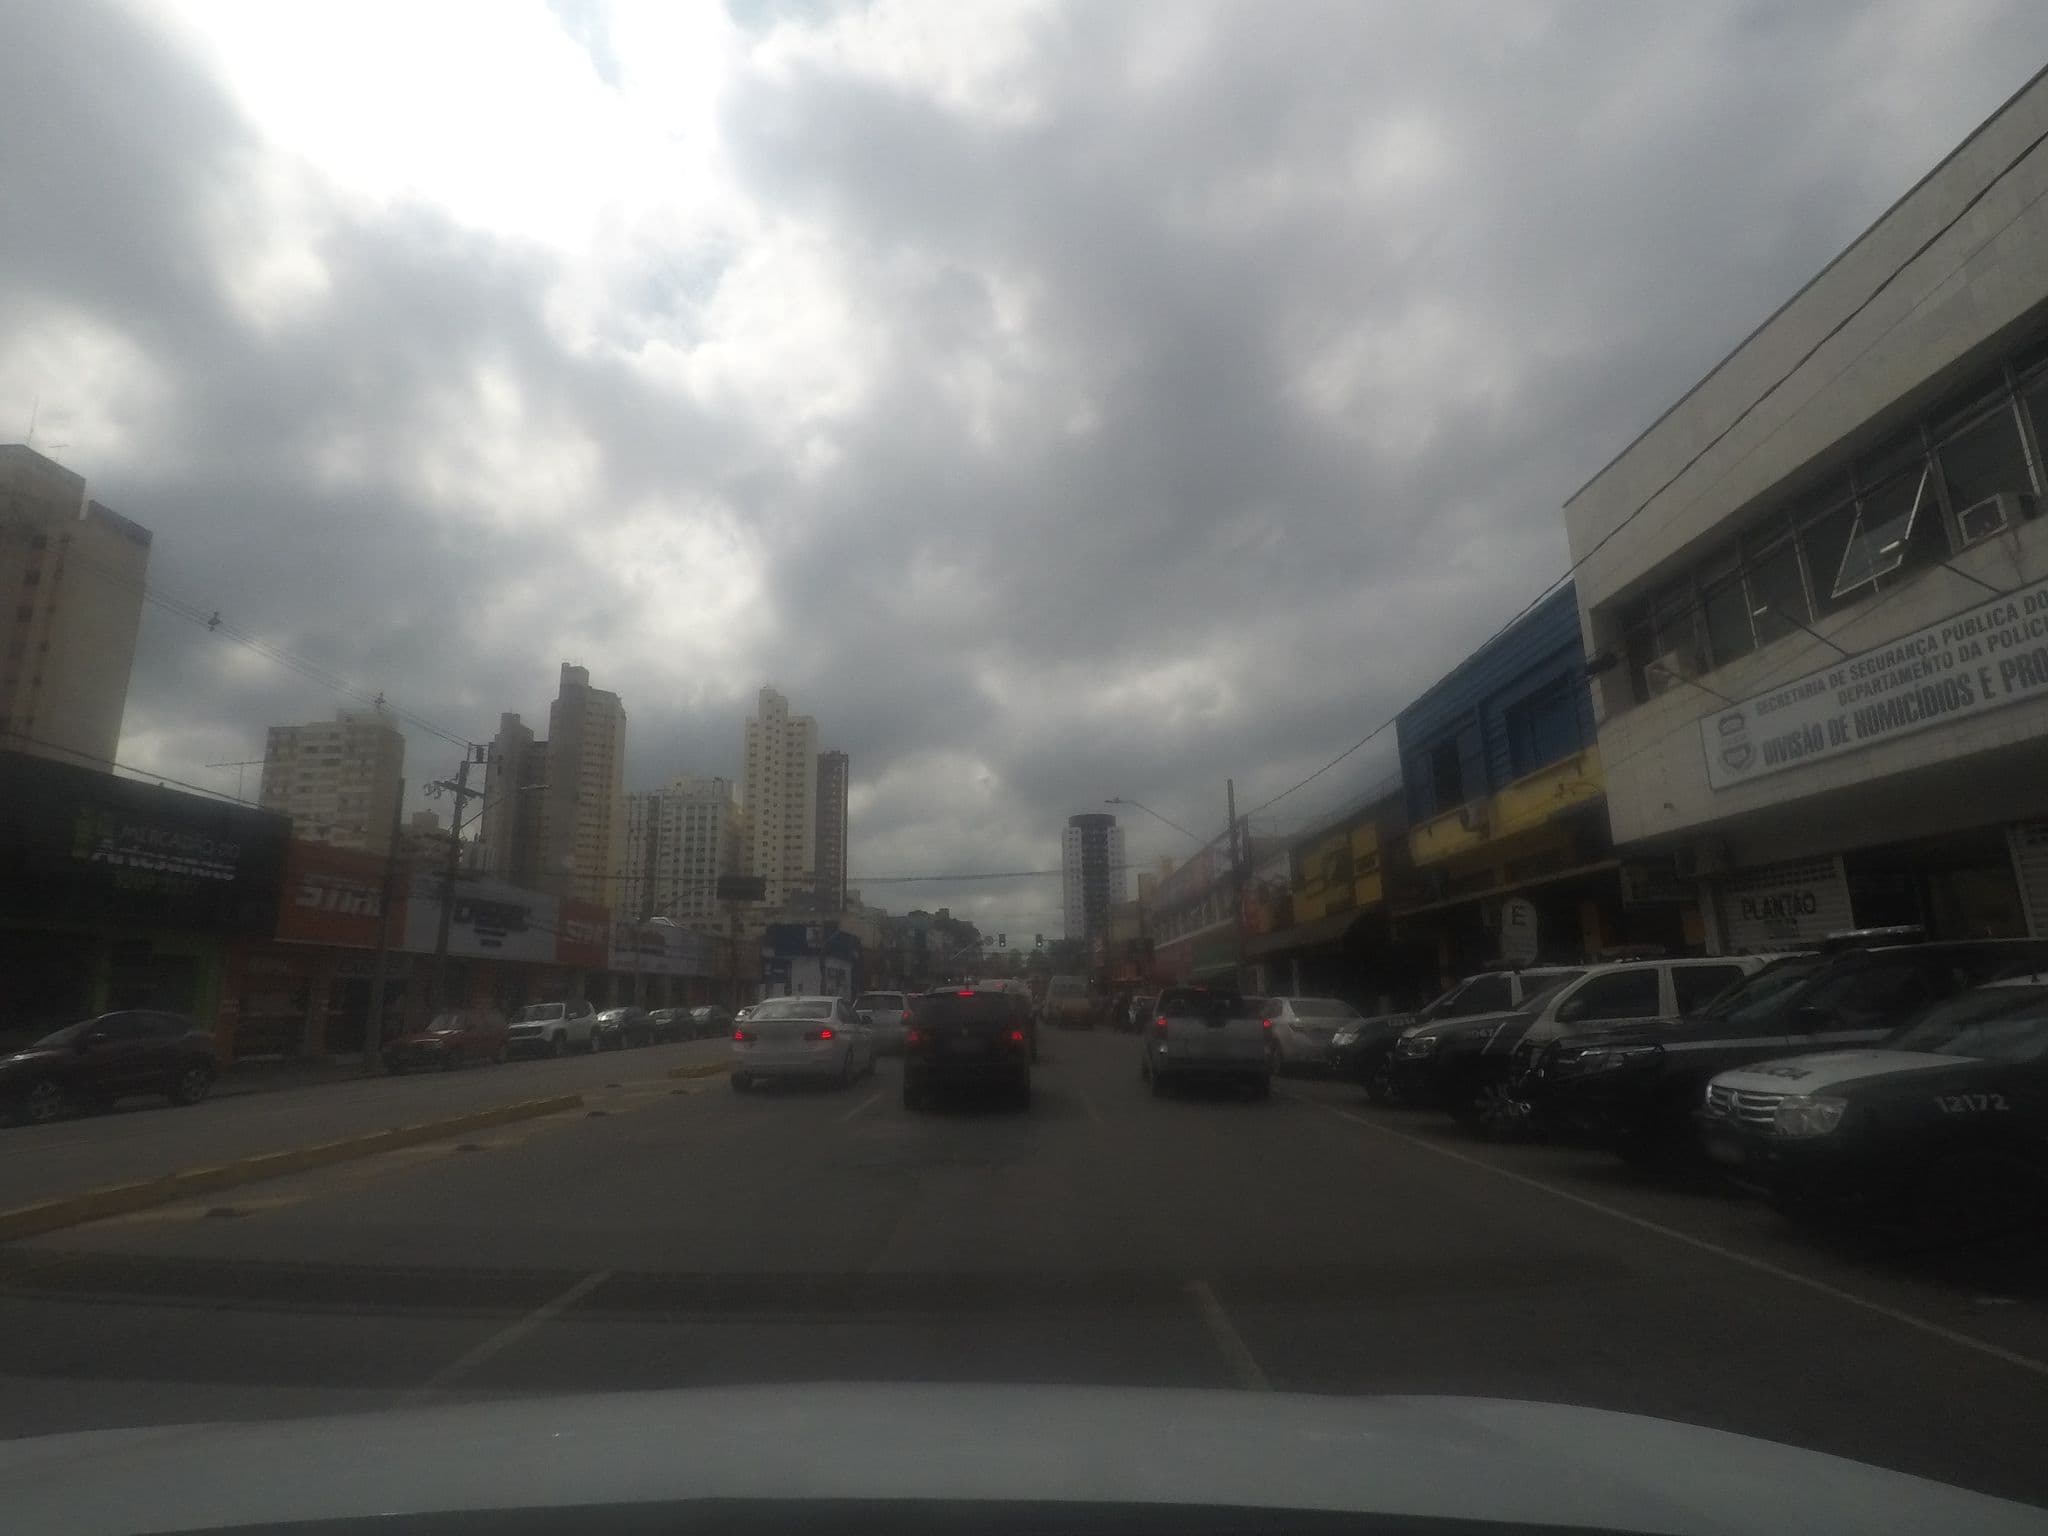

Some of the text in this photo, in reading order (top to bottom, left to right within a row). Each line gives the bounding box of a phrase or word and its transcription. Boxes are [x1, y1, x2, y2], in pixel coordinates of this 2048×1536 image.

[1755, 678, 1827, 716] SECRETARIA
[1828, 670, 1847, 689] DE
[1837, 650, 1954, 706] DEPARTAMENTO
[1958, 641, 1983, 663] DA
[1827, 714, 1850, 748] DE
[1853, 672, 1976, 739] HOMICÍDIOS
[1977, 665, 1996, 700] E
